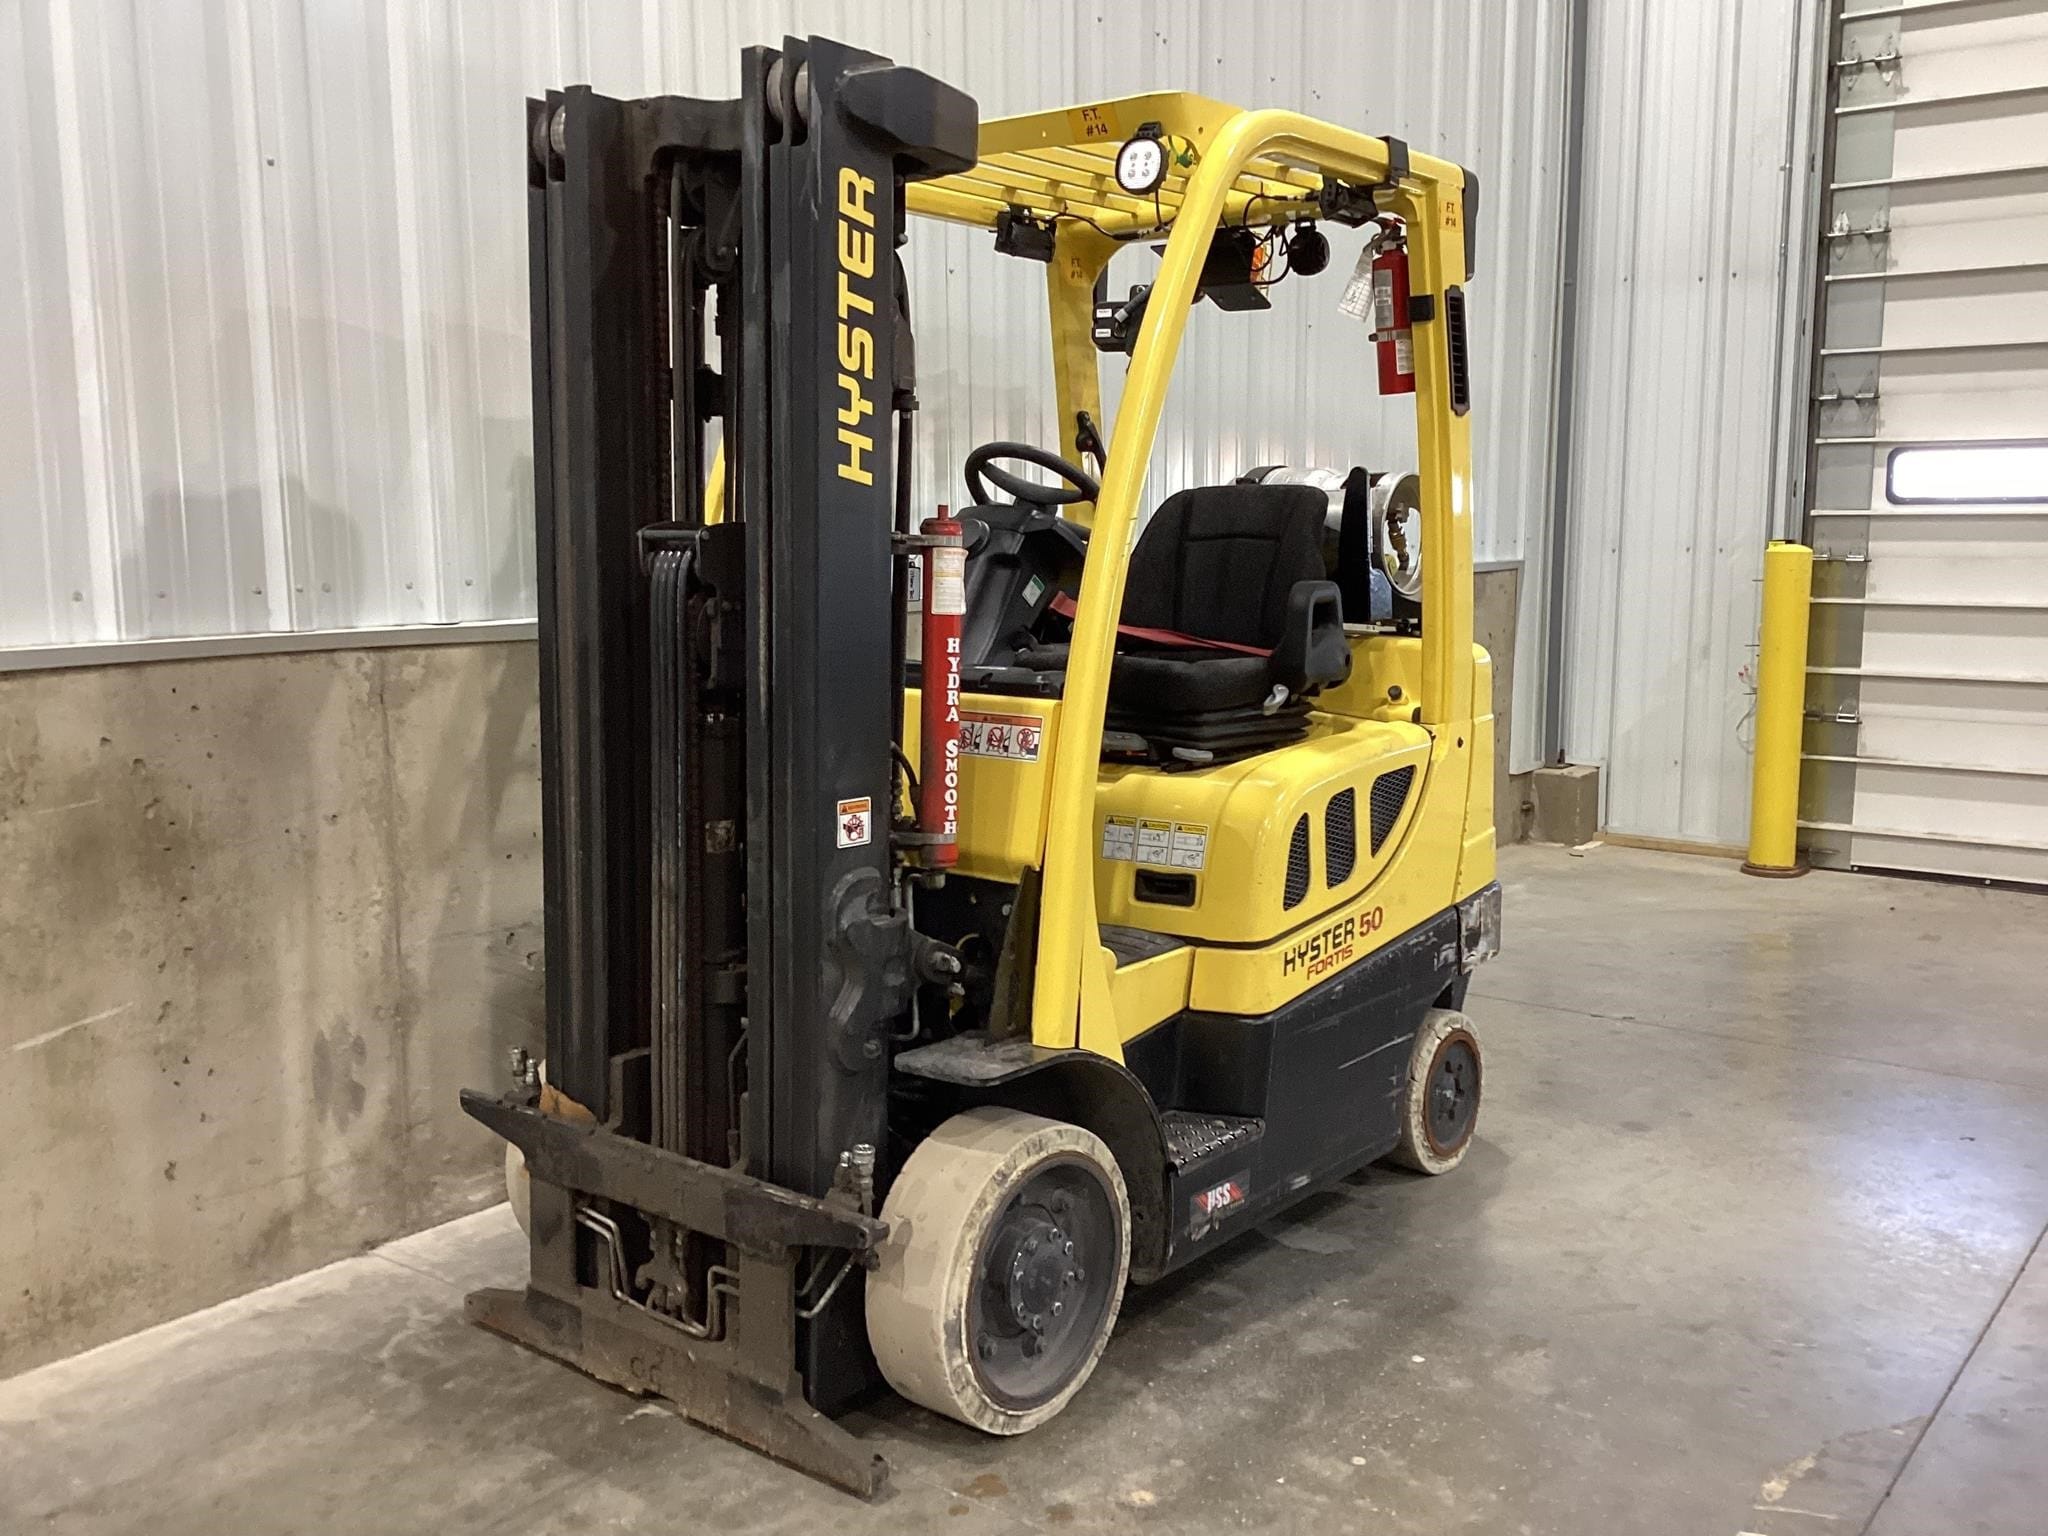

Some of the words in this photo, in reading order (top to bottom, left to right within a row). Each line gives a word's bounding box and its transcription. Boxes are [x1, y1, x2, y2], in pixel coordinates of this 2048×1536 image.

[1081, 108, 1101, 121] F.T.
[1086, 123, 1108, 137] #14
[838, 167, 875, 487] HYSTER
[945, 637, 960, 722] HYDRA
[944, 738, 959, 835] SMOOTH
[1283, 917, 1355, 977] HYSTER
[1359, 906, 1383, 937] 50
[1307, 944, 1353, 980] FORTIS
